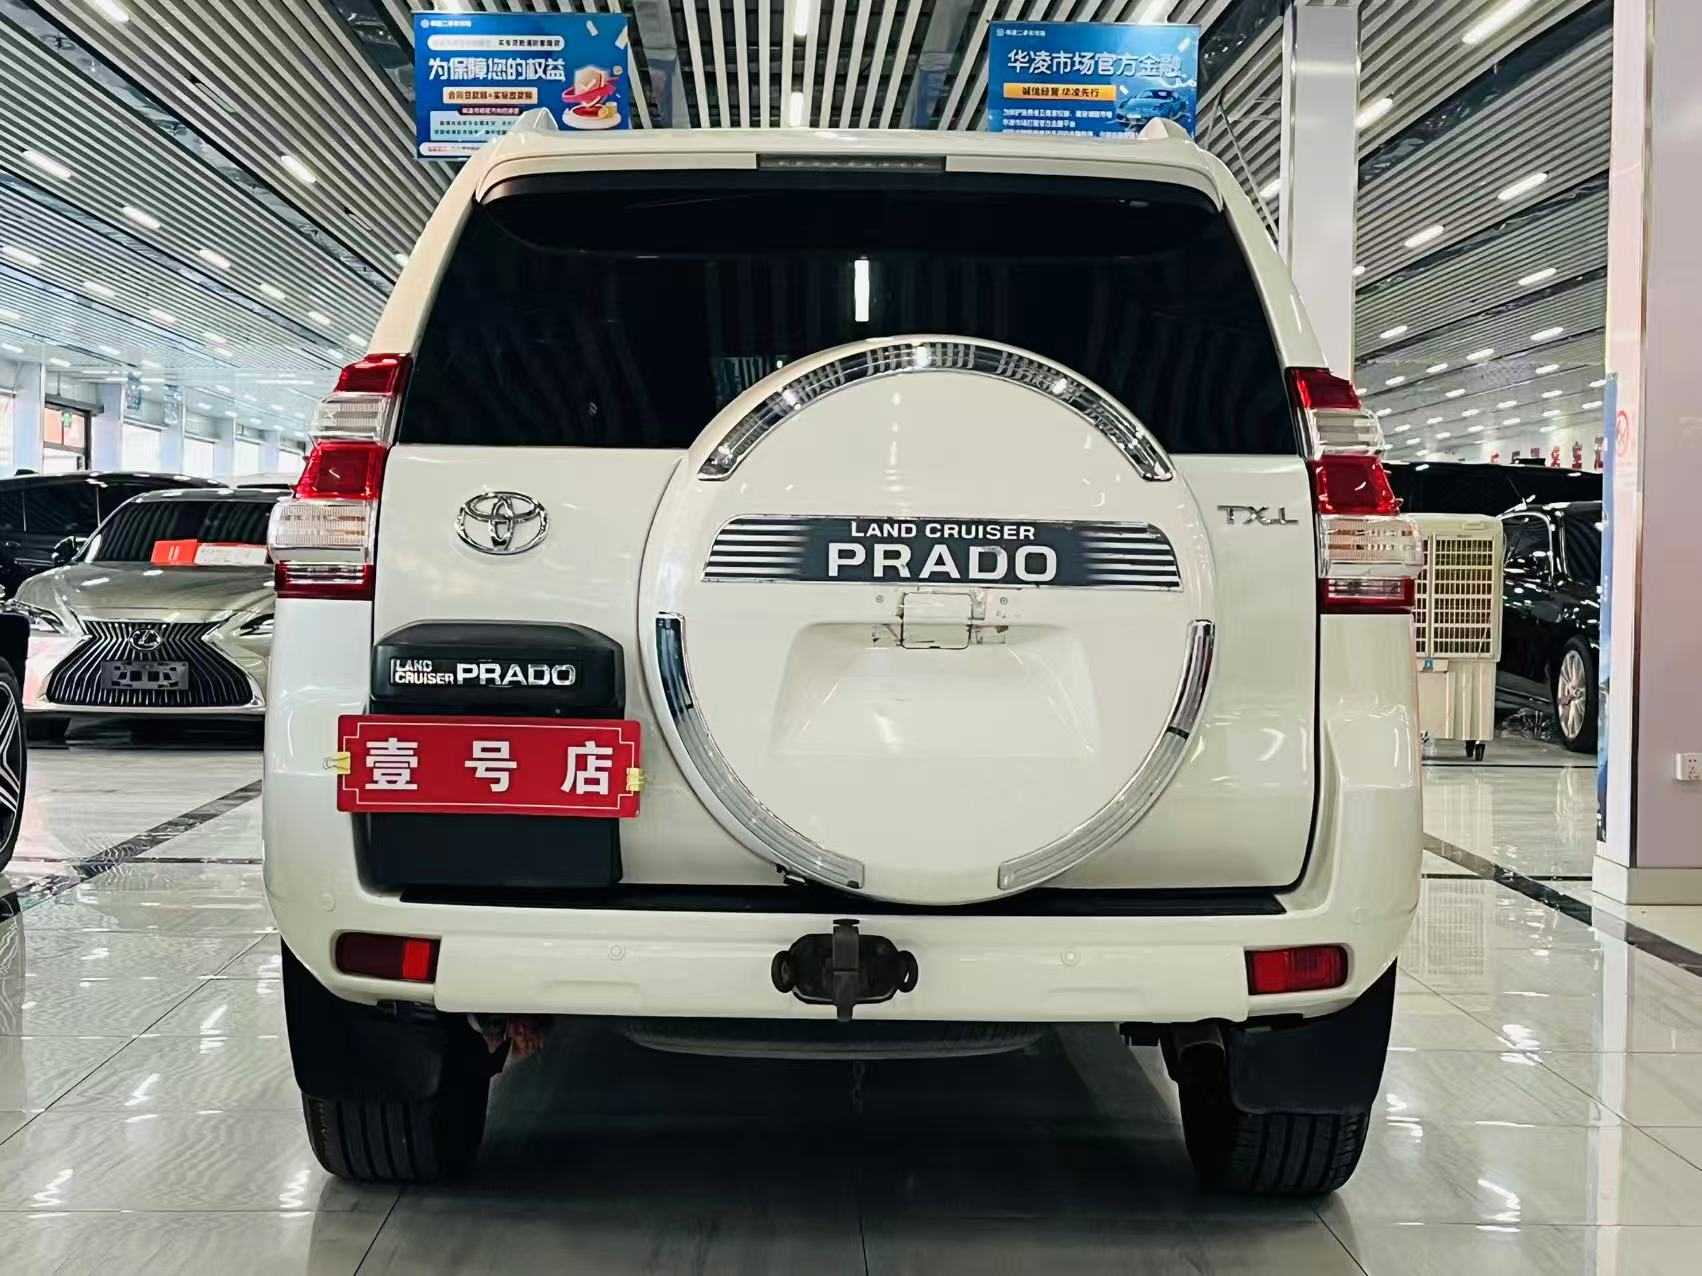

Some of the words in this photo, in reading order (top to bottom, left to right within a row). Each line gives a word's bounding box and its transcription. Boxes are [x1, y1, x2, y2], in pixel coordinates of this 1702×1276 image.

[428, 57, 566, 81] 为保障您的权益
[850, 521, 918, 540] LAND
[925, 523, 1036, 541] CRUISER
[827, 542, 1058, 582] PRADO
[395, 659, 433, 673] LAND
[456, 663, 577, 686] PRADO
[395, 672, 455, 685] CRUISER
[364, 737, 613, 795] 壹号店
